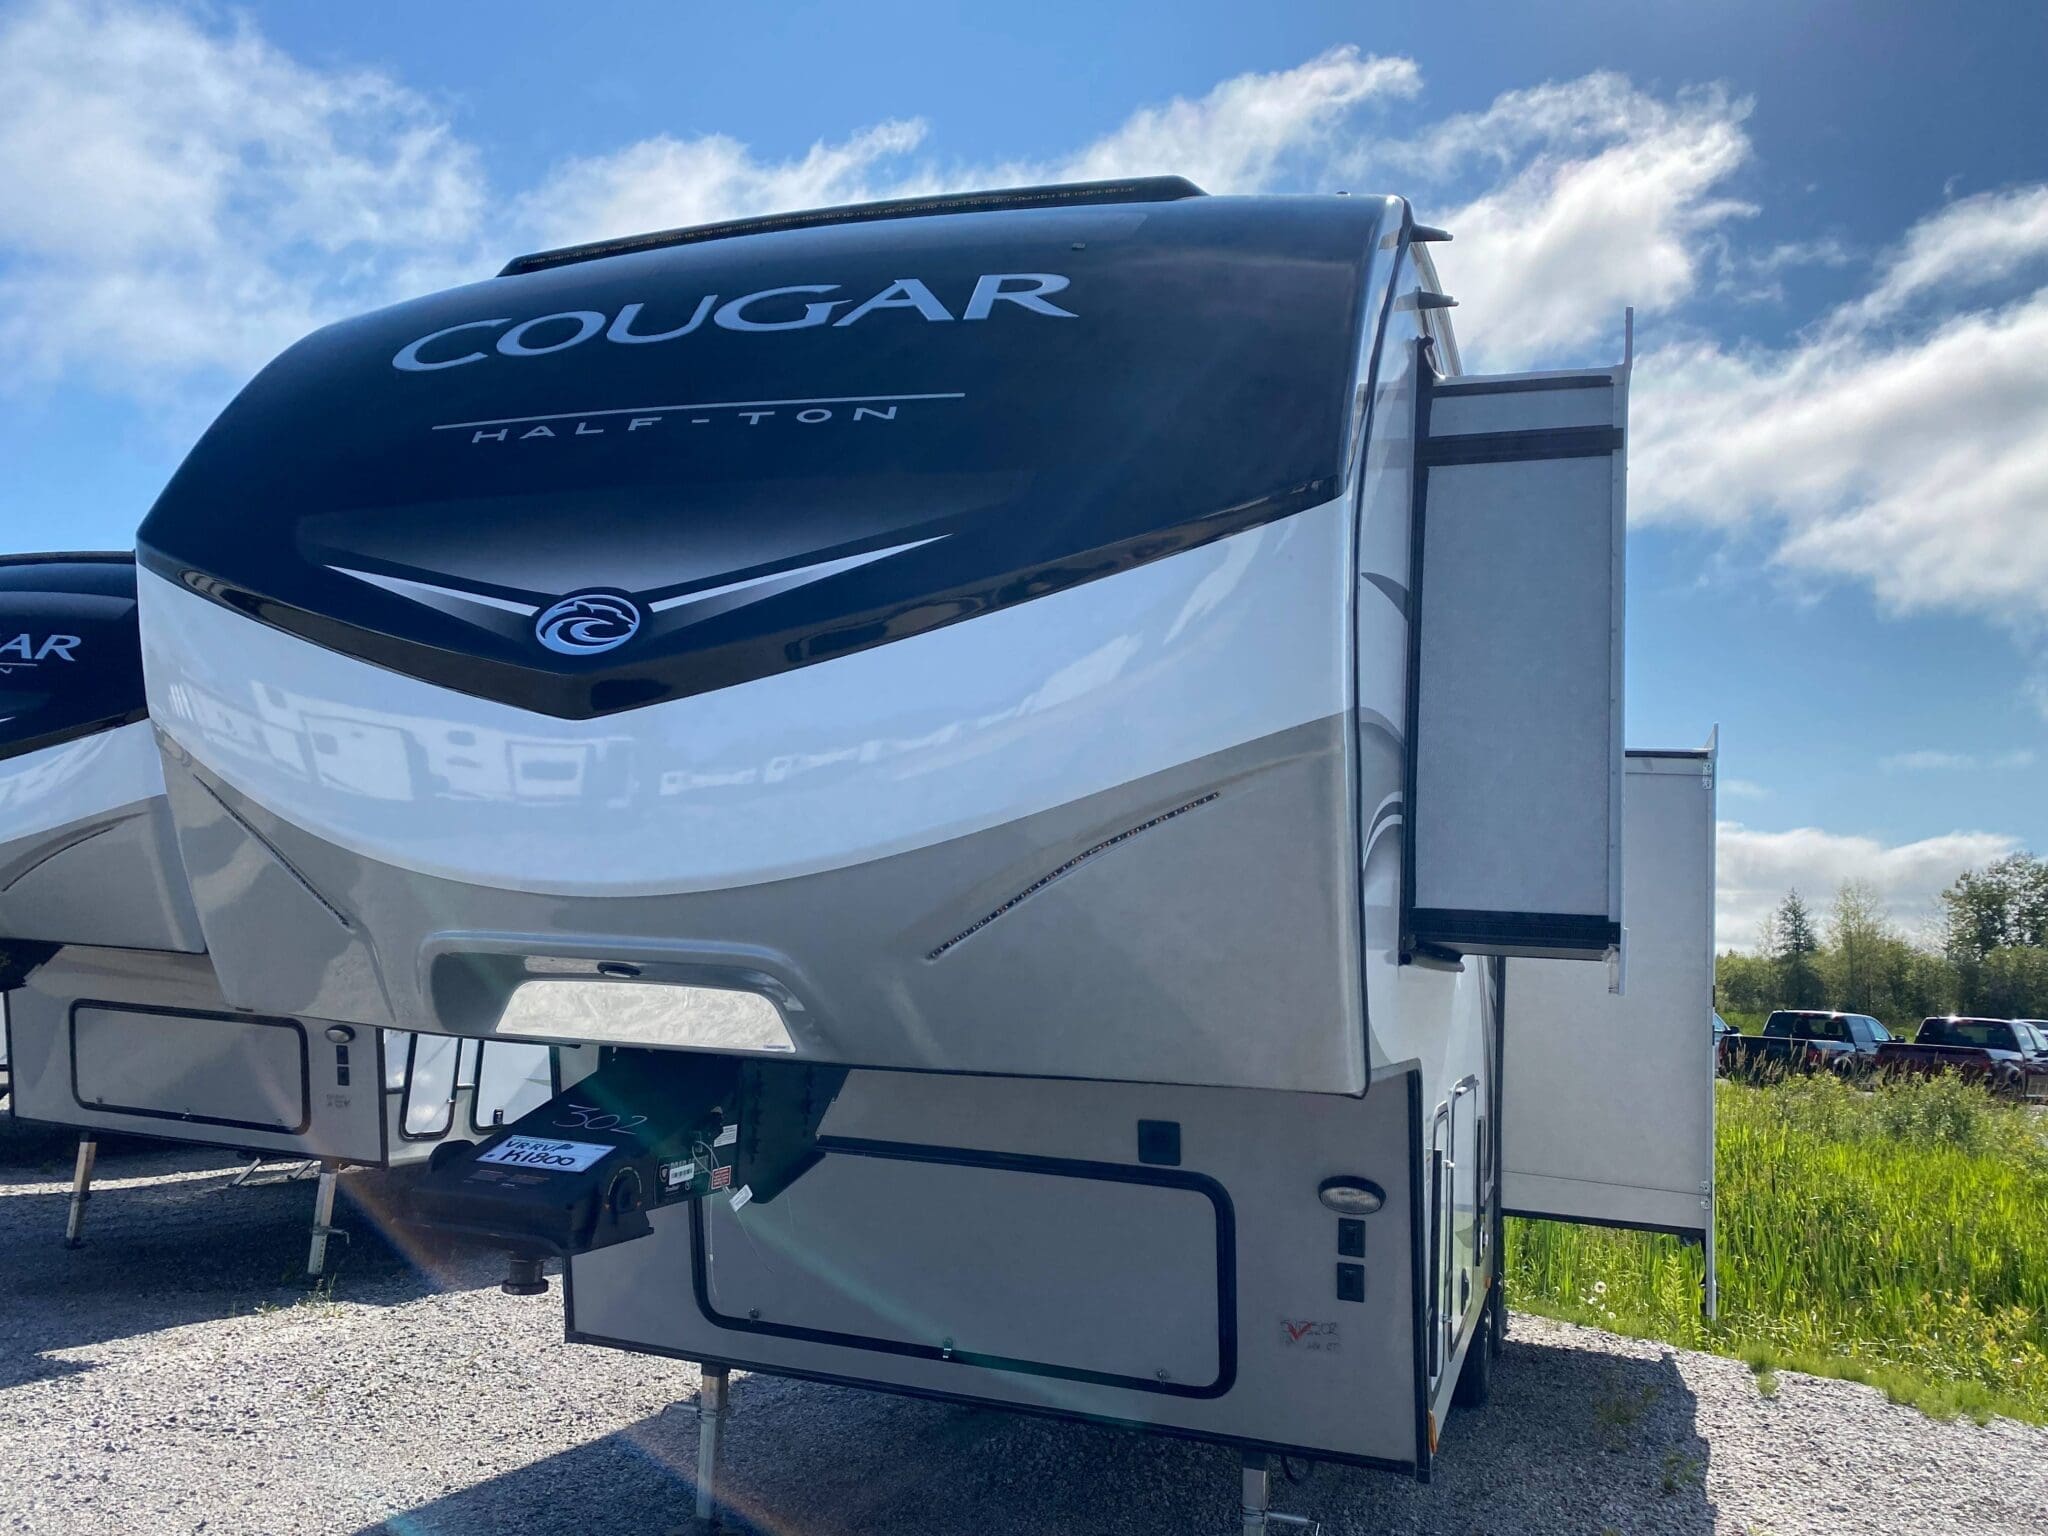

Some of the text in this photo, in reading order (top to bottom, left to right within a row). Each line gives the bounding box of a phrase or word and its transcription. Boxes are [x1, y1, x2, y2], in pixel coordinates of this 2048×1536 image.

[392, 273, 1079, 372] COUGAR
[552, 1104, 648, 1135] 302
[499, 1149, 576, 1167] K1800
